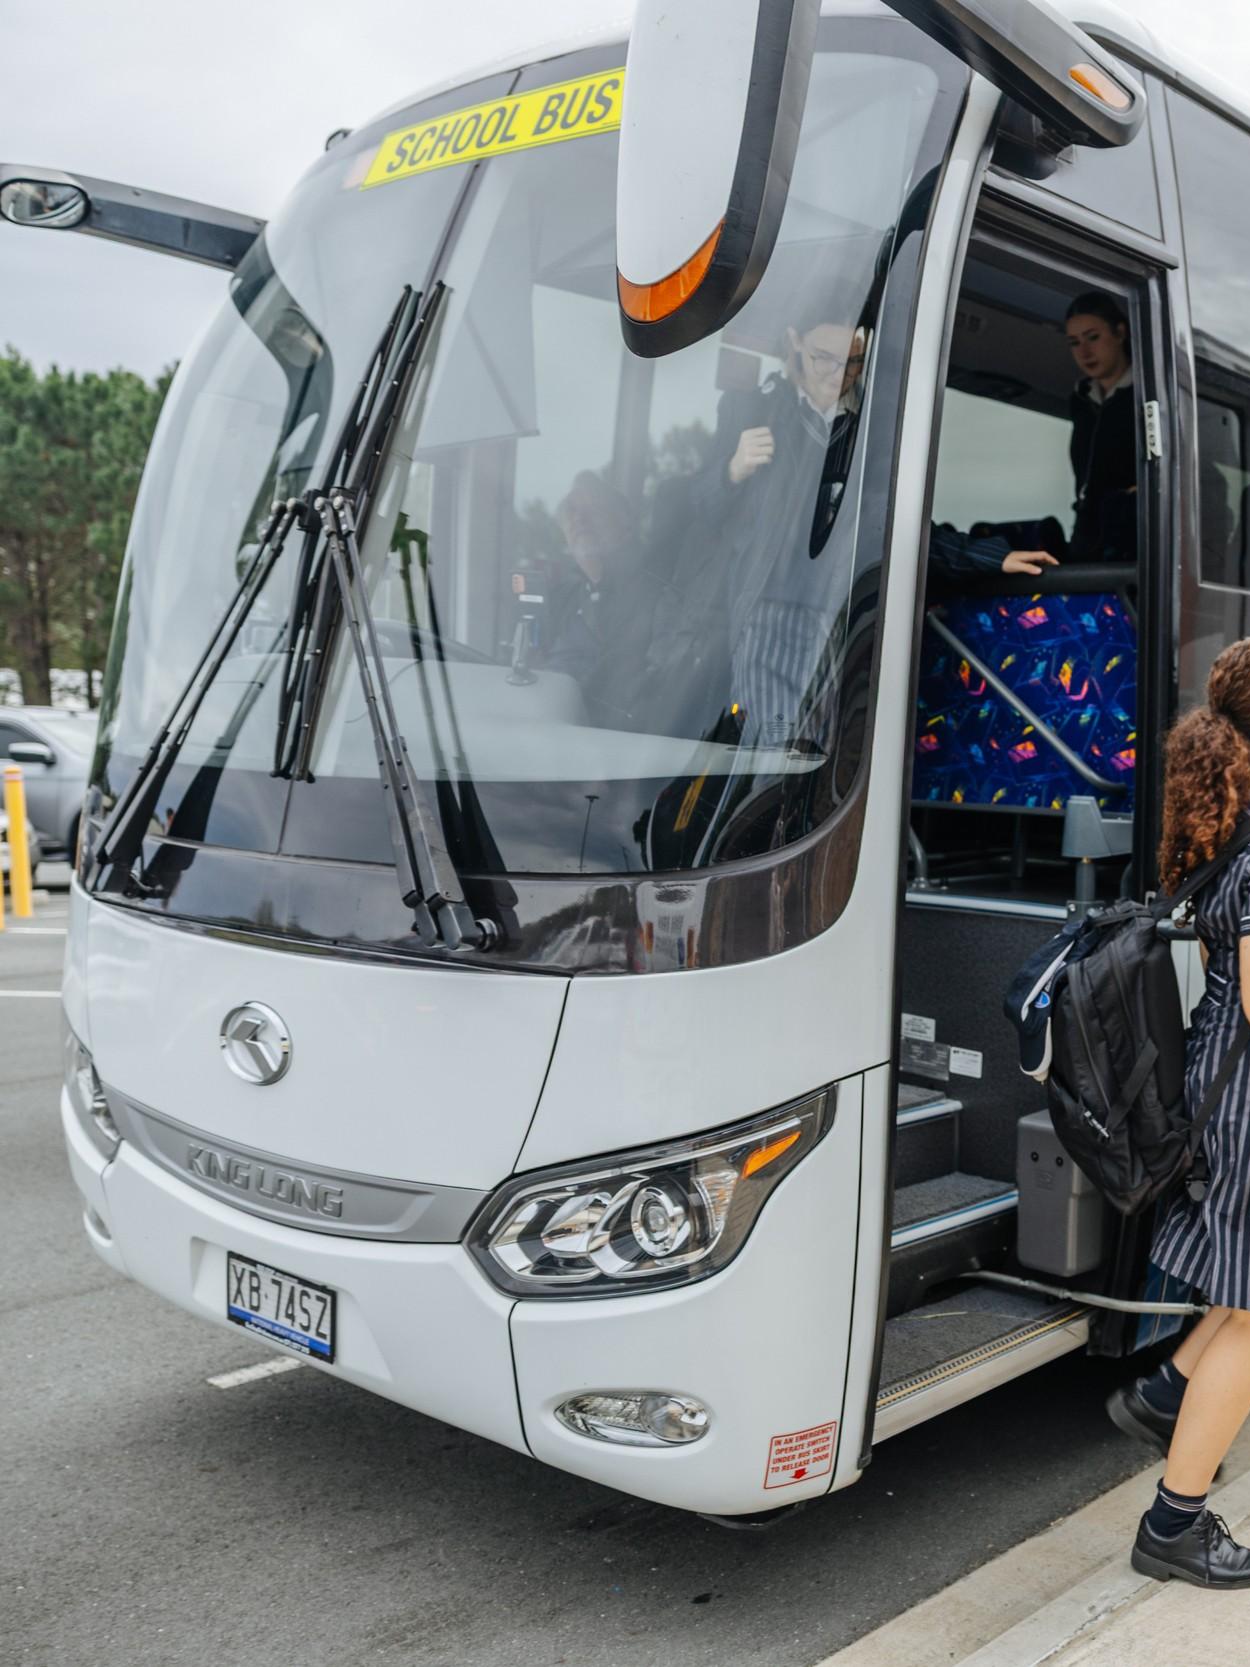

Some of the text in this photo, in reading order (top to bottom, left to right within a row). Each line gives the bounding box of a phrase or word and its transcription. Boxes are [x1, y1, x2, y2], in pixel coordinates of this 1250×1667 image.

[386, 78, 620, 173] SCHOOL BUS
[187, 1143, 343, 1218] KING LONG
[795, 1427, 832, 1442] EMERGENCY
[773, 1454, 795, 1464] UNDER
[812, 1445, 830, 1454] SKIRT
[775, 1437, 830, 1455] OPERATE SWITCH
[781, 1459, 810, 1471] RELEASE
[812, 1453, 829, 1463] DOOR
